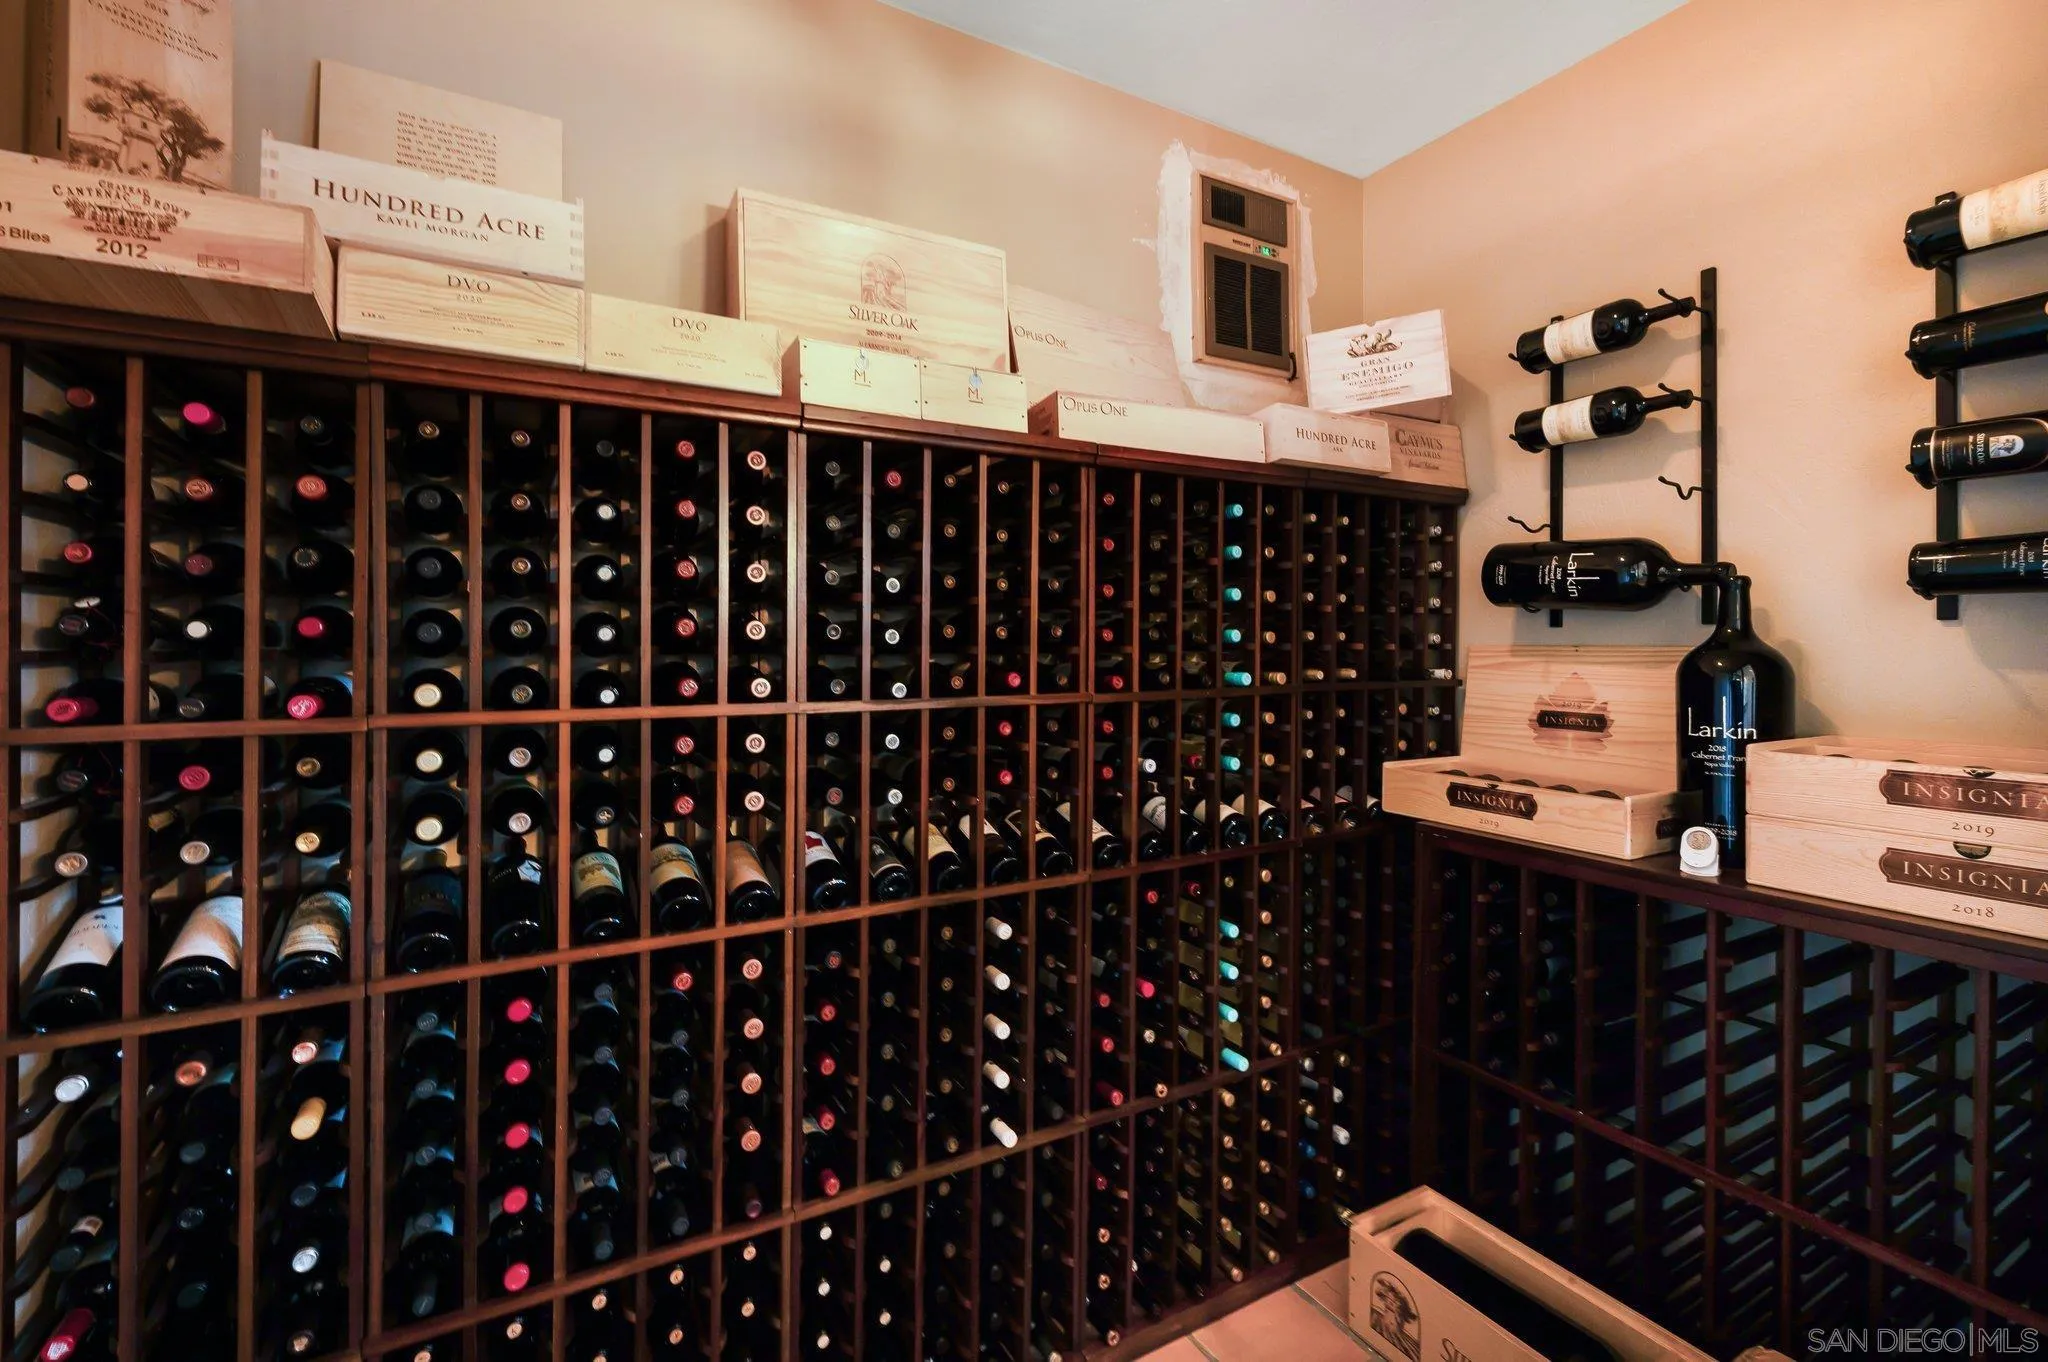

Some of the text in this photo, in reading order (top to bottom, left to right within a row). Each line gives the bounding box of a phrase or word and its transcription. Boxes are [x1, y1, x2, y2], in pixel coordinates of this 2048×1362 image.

[52, 184, 191, 220] CANTENAC BROWN
[313, 178, 546, 241] HUNDRED ACRE
[376, 212, 489, 243] KAYLI MORGAN
[96, 238, 148, 260] 2012
[447, 274, 491, 293] DVO
[672, 316, 707, 333] DVO
[848, 304, 920, 333] SILVER OAK
[1341, 361, 1415, 381] ENEMIGO
[1360, 356, 1391, 368] GRAN
[1296, 427, 1377, 451] HUNDRED ACRE
[1395, 428, 1443, 450] CAYMUS
[1977, 433, 1986, 452] SILVER
[1399, 448, 1441, 459] VINEYARDS
[1550, 555, 1559, 580] Cabernet
[1567, 552, 1600, 597] Larkin
[1561, 701, 1582, 709] 2019
[1545, 716, 1598, 727] INSIGNIA
[1688, 696, 1758, 740] Larkin
[1691, 750, 1747, 762] Cabernet Fran
[1708, 744, 1727, 752] 2018
[1704, 761, 1735, 770] Napa Valley
[1457, 790, 1526, 812] INSIGNIA
[1904, 782, 2048, 809] INSIGNIA
[1479, 817, 1500, 828] 2019
[1952, 822, 1995, 837] 2019
[1904, 861, 2048, 896] INSIGNIA
[1953, 904, 1995, 918] 2018
